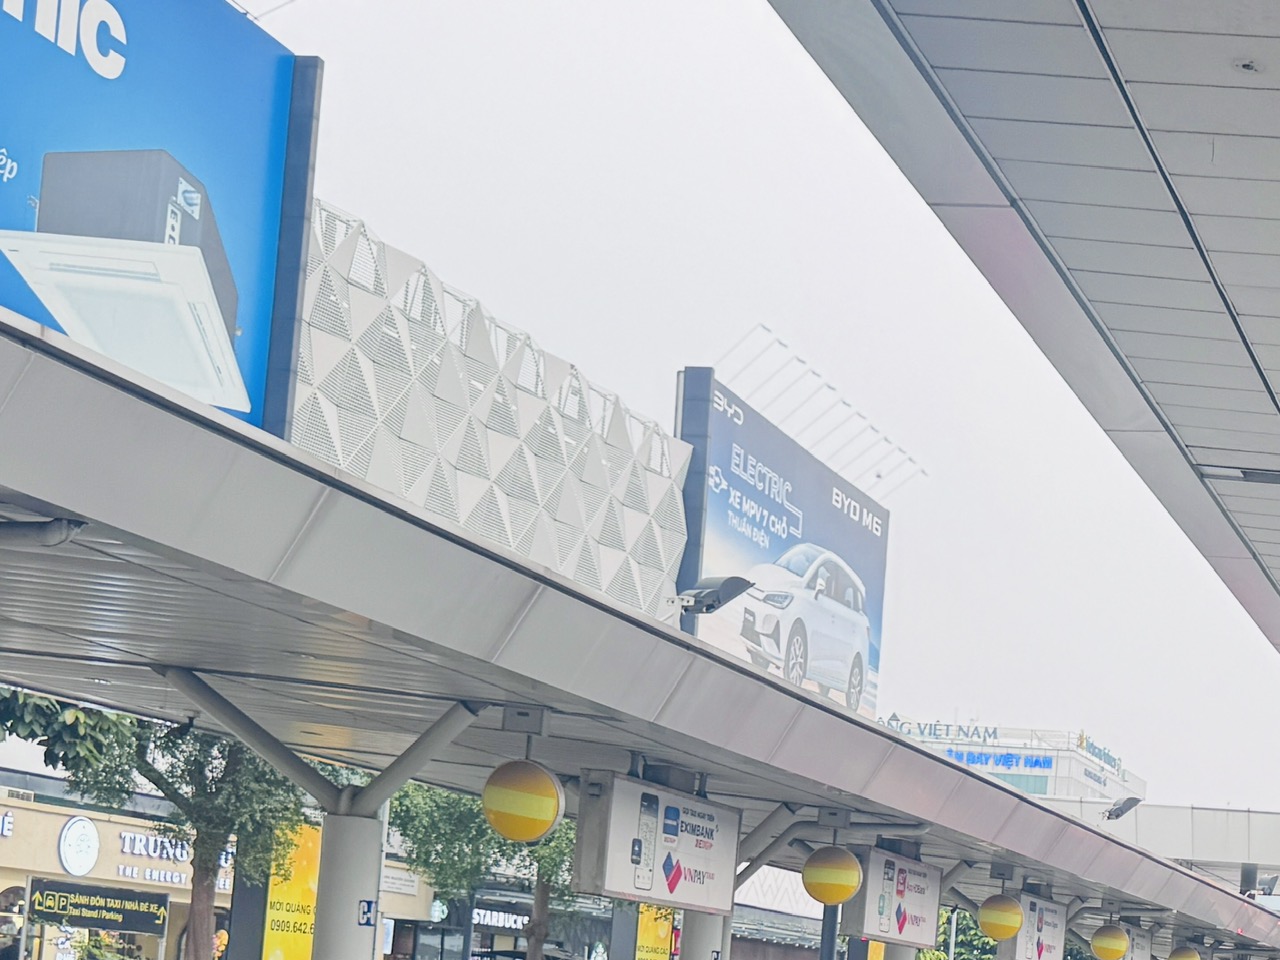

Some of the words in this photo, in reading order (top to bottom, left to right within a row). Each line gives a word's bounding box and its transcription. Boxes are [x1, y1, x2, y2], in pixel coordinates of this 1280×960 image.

[713, 390, 744, 425] BYD
[730, 442, 793, 505] ELECTRIC
[728, 487, 741, 505] XE
[742, 497, 763, 524] MPV
[762, 507, 769, 527] 7
[832, 487, 860, 522] BYD
[862, 507, 882, 537] M6
[916, 719, 952, 738] VIỆT
[957, 724, 999, 740] NAM
[679, 820, 715, 841] EXIMBANK
[119, 831, 189, 862] TRUNG
[118, 865, 138, 879] THE
[145, 867, 188, 884] ENERGY
[683, 866, 706, 885] VNPAY
[60, 899, 66, 911] P
